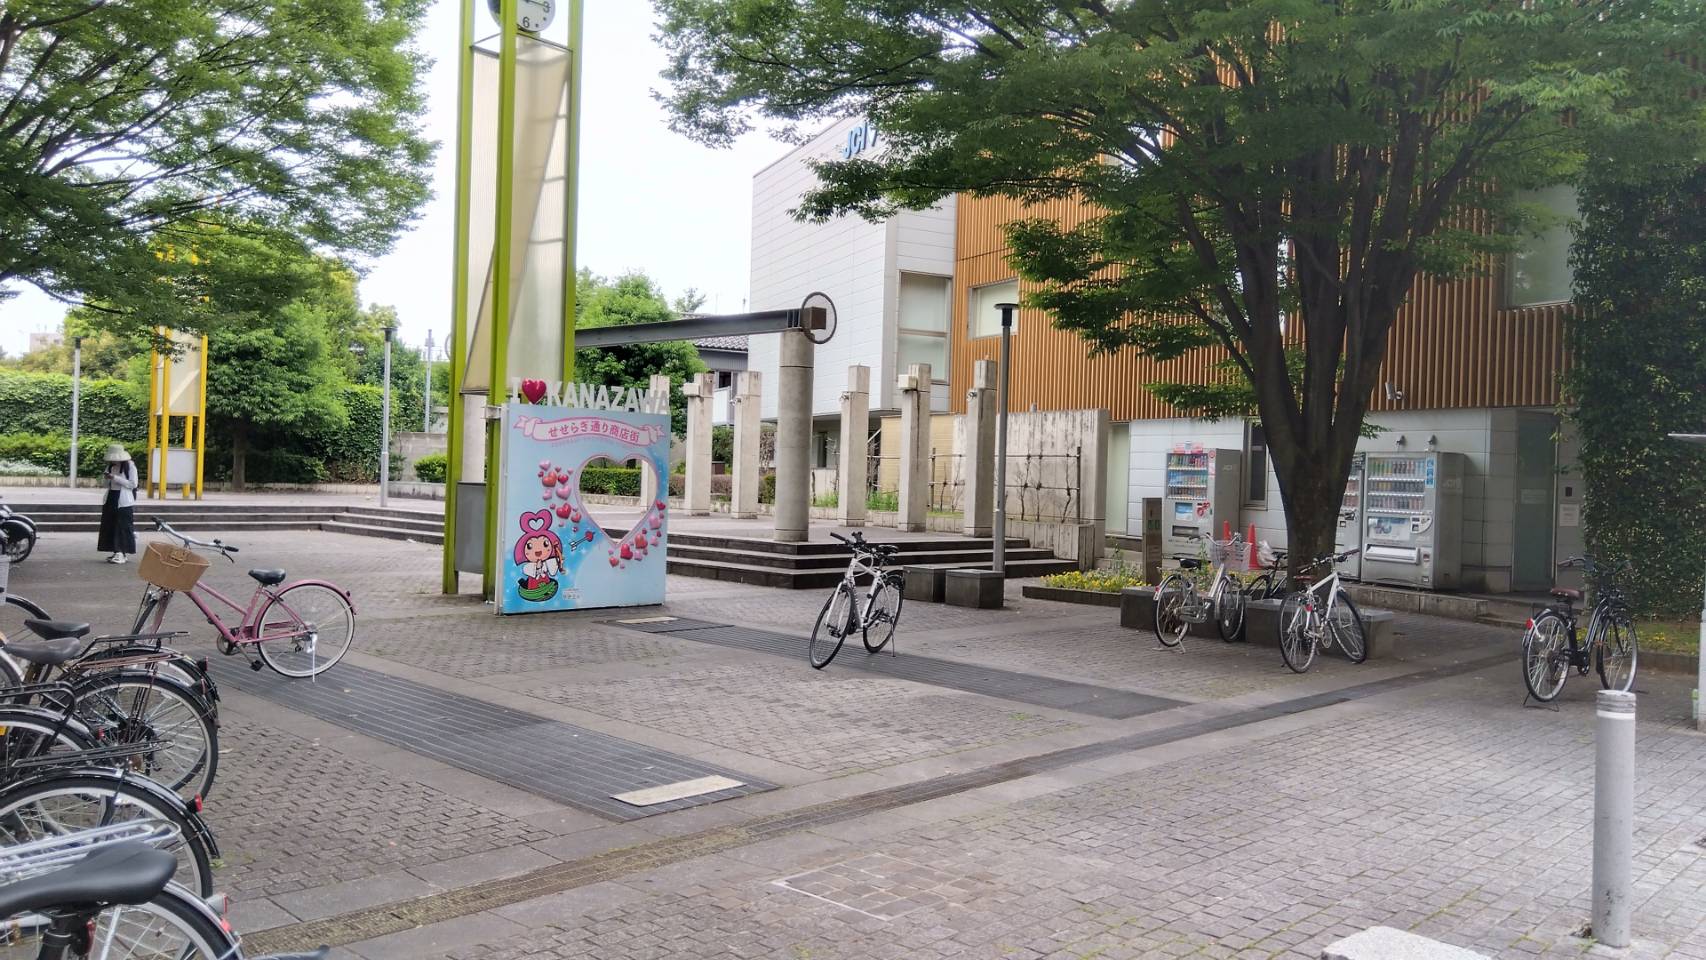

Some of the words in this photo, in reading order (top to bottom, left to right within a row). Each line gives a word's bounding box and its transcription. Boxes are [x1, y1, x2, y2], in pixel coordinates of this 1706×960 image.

[523, 16, 530, 28] 6
[510, 377, 521, 404] I
[547, 381, 670, 414] KANAZAWA
[548, 420, 639, 442] せせらぎ通り商店街
